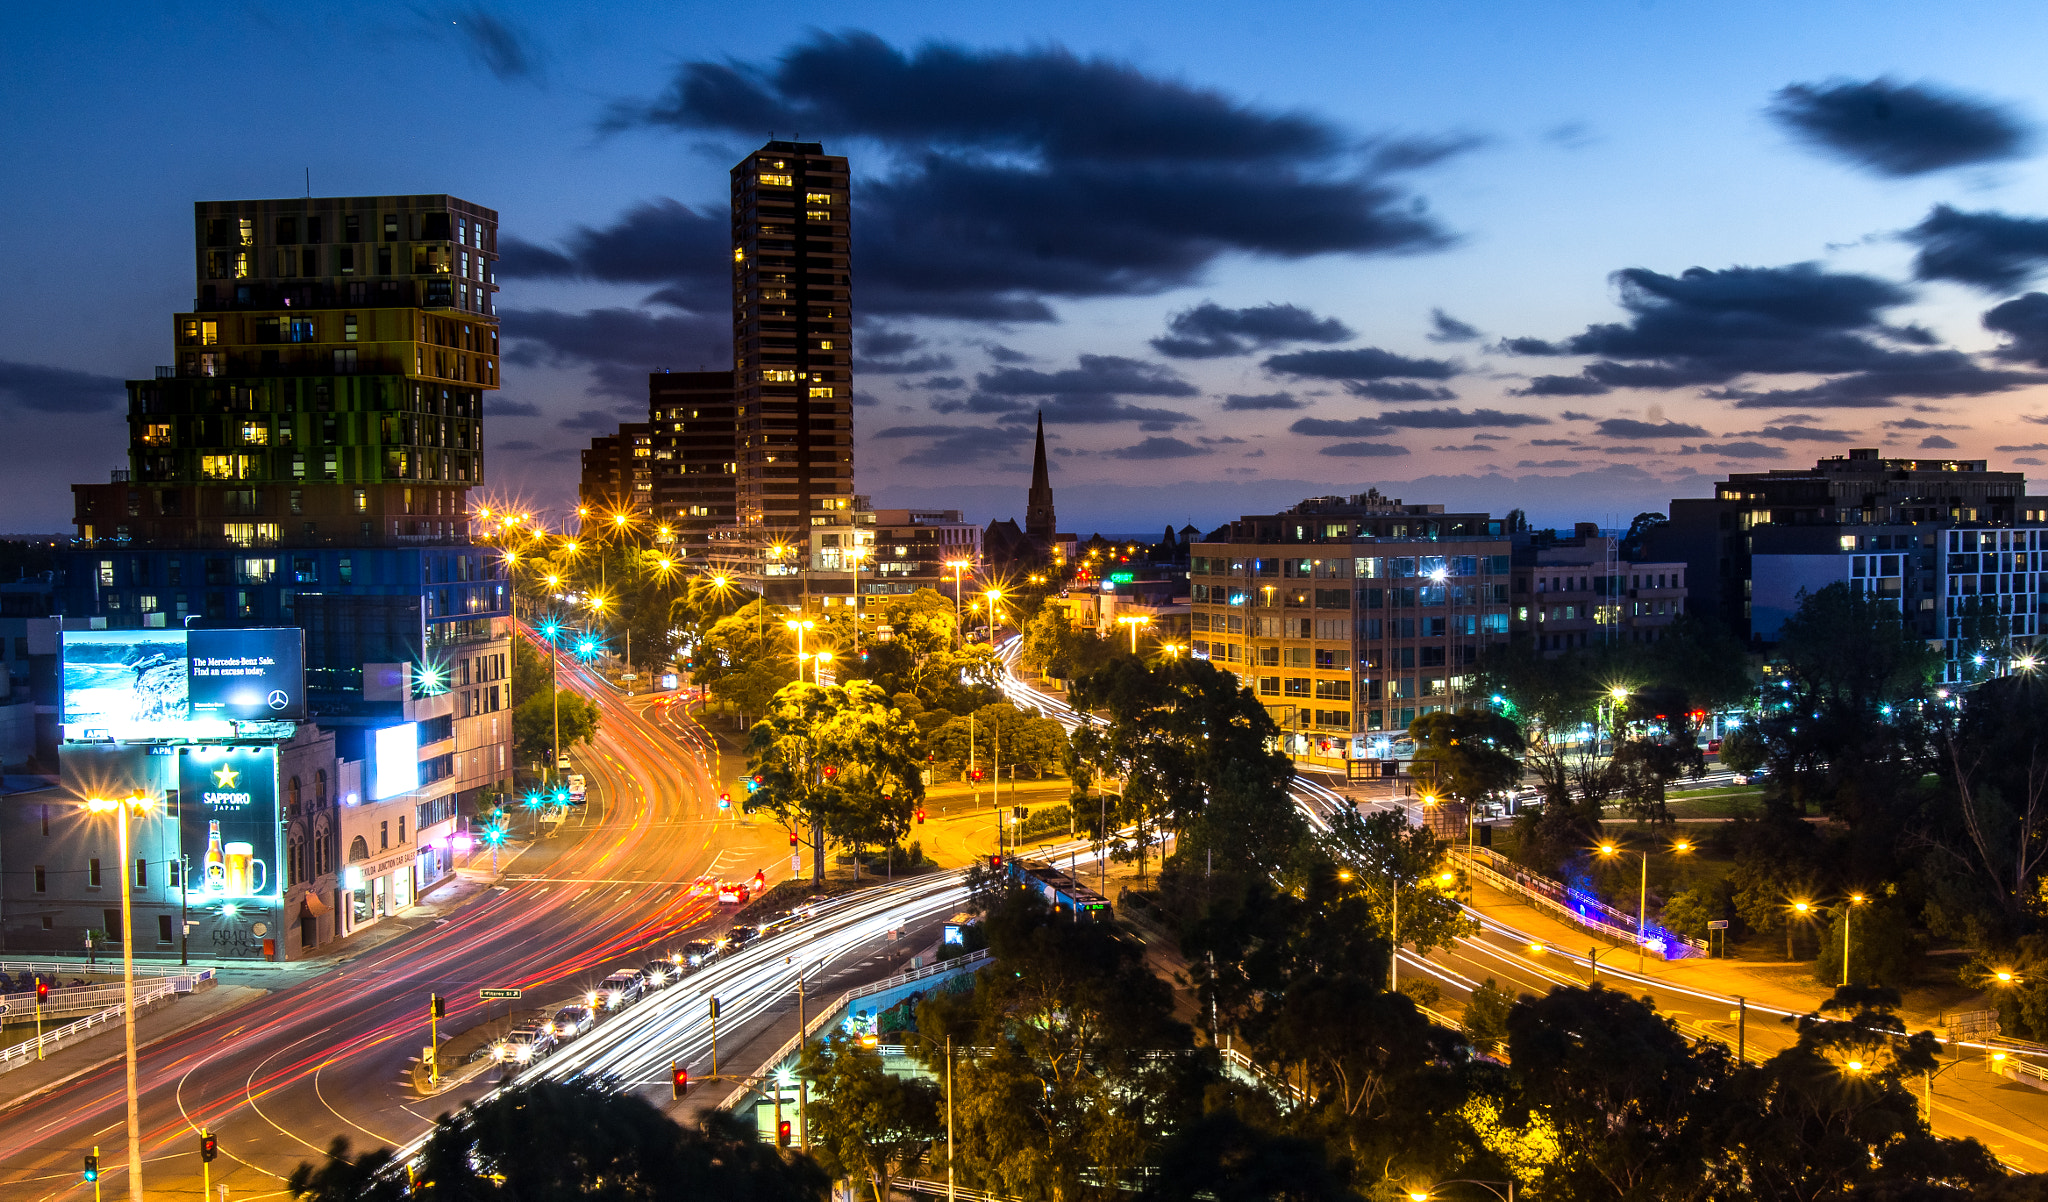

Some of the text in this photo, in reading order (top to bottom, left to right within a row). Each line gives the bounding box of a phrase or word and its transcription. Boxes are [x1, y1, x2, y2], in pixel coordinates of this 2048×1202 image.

[193, 656, 276, 666] The Mercedes-Benz Sale.
[193, 667, 267, 676] Find an excuse today.
[152, 746, 172, 755] APN
[203, 792, 251, 805] SAPPORO
[378, 859, 396, 872] JUNCTION
[396, 856, 404, 866] CAR
[404, 851, 415, 862] SALES
